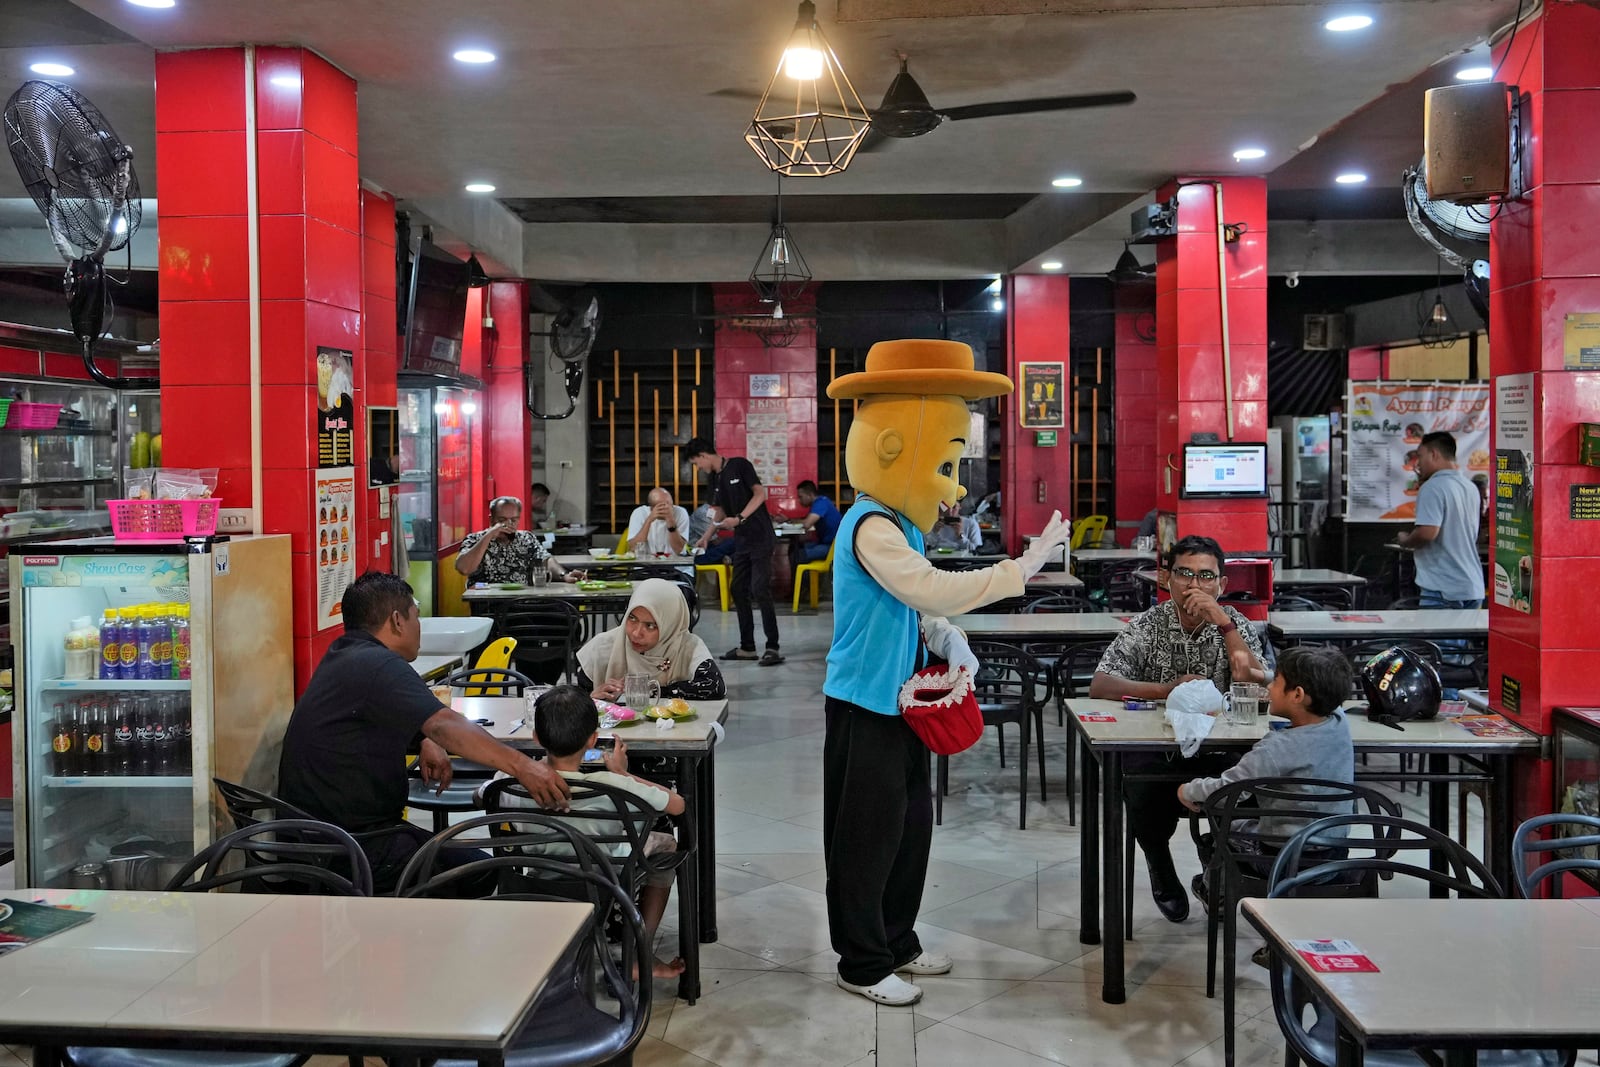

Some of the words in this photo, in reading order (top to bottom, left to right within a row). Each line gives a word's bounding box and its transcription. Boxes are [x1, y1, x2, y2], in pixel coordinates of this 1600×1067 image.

[757, 400, 785, 409] KING
[1386, 397, 1435, 414] Ayam
[122, 652, 137, 660] TEA
